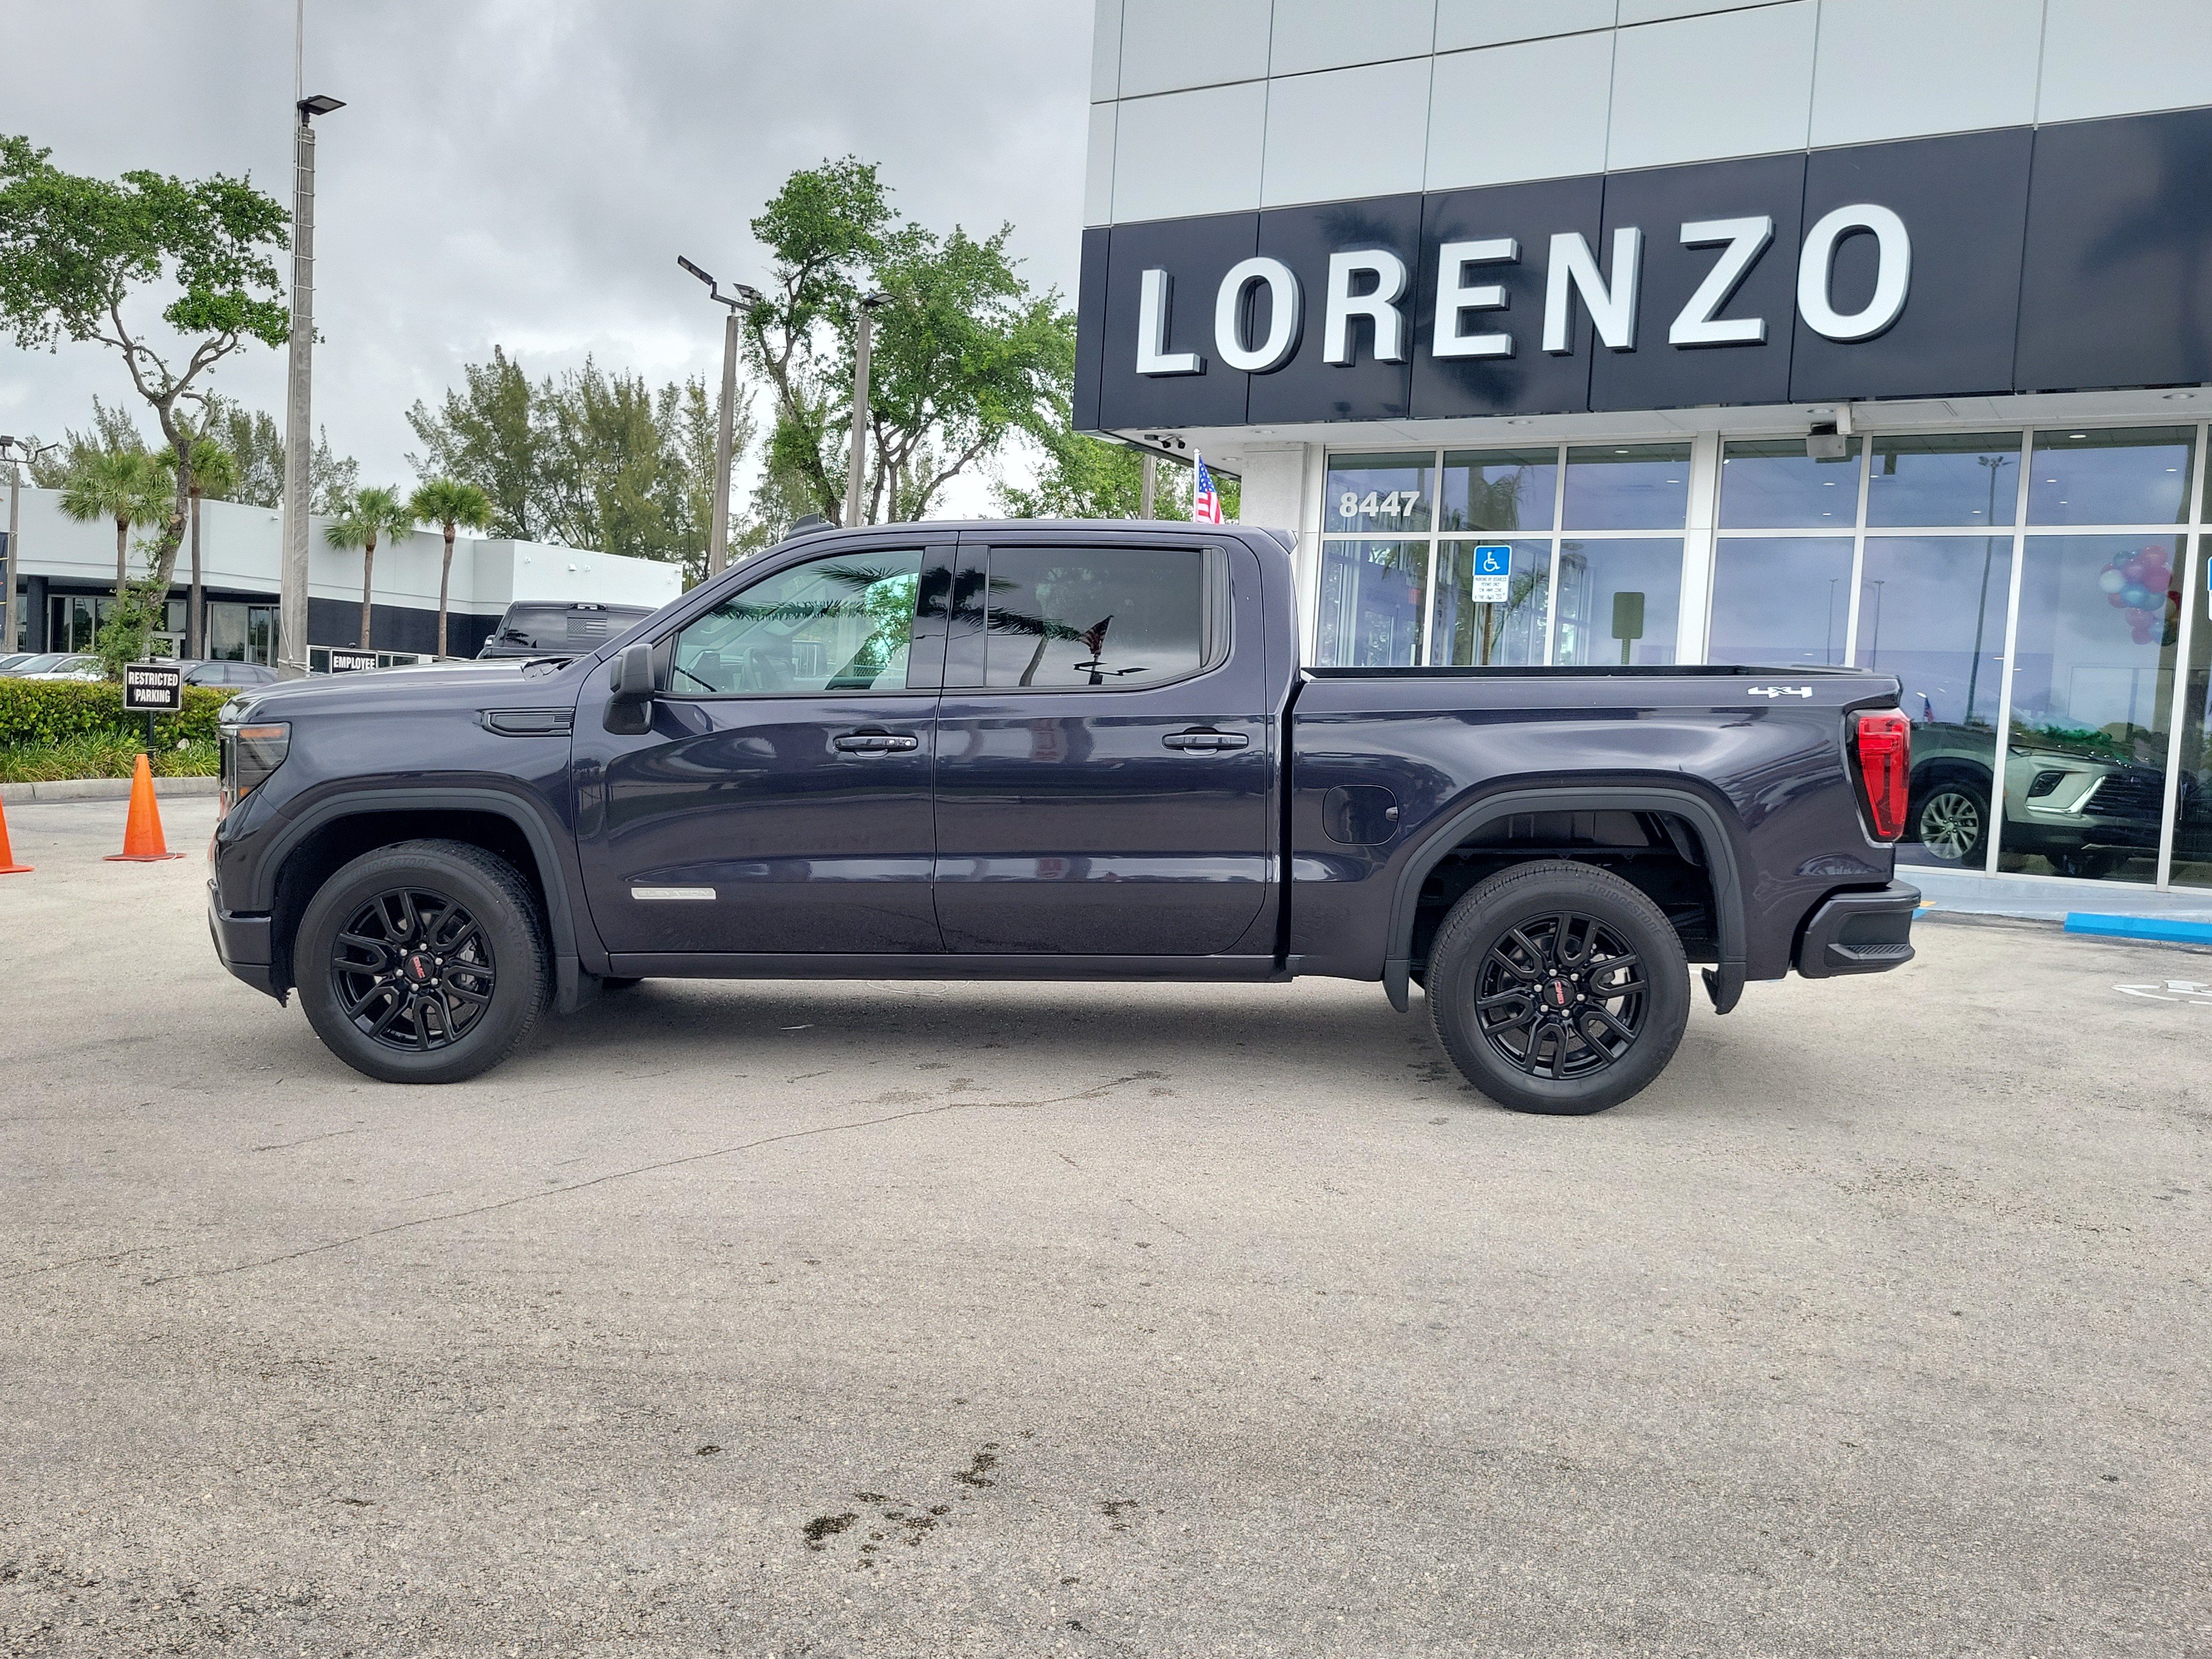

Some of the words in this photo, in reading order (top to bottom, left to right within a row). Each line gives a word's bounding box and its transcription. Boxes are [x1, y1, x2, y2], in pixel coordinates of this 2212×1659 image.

[1136, 204, 1912, 375] LORENZO
[1339, 491, 1420, 517] 8447
[334, 656, 375, 670] EMPLOYEE
[128, 672, 178, 686] RESTRICTED
[136, 689, 171, 702] PARKING
[413, 956, 426, 979] GMC
[1554, 981, 1565, 1005] GMC
